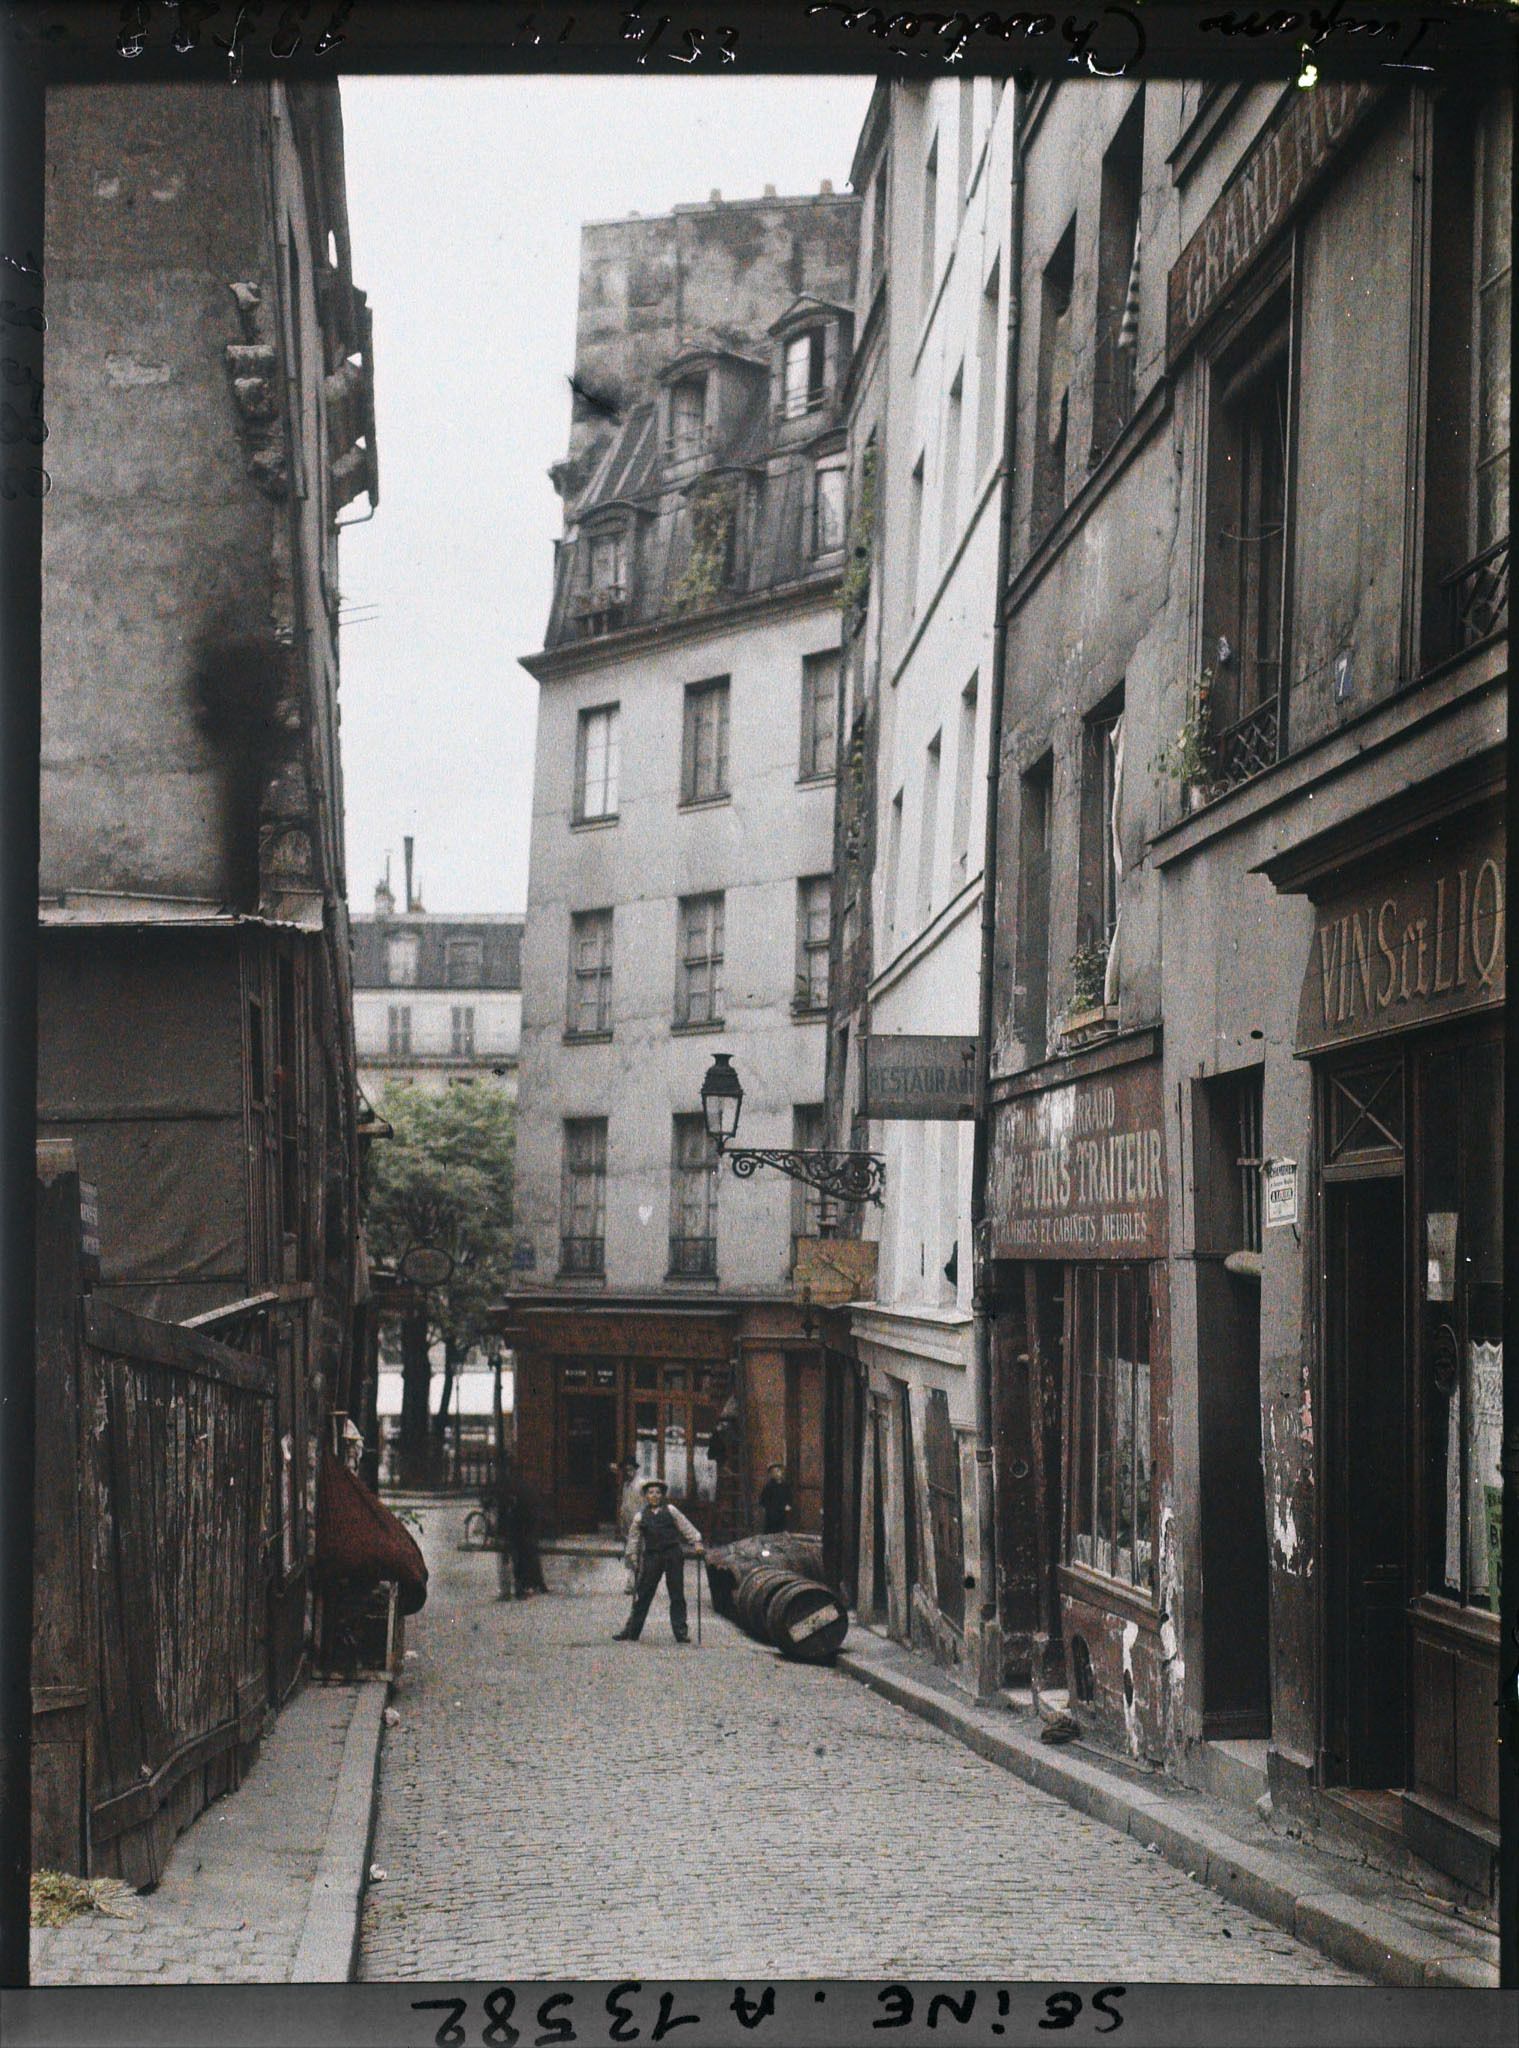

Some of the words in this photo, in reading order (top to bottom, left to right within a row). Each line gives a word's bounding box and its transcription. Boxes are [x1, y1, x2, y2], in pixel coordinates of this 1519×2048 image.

[1186, 128, 1282, 327] GRAND
[1319, 898, 1397, 1022] VINS
[1433, 859, 1505, 993] LIQ
[1031, 1142, 1071, 1211] VINS
[1075, 1129, 1164, 1204] TRAITEUR
[1053, 1212, 1096, 1244] CABINETS
